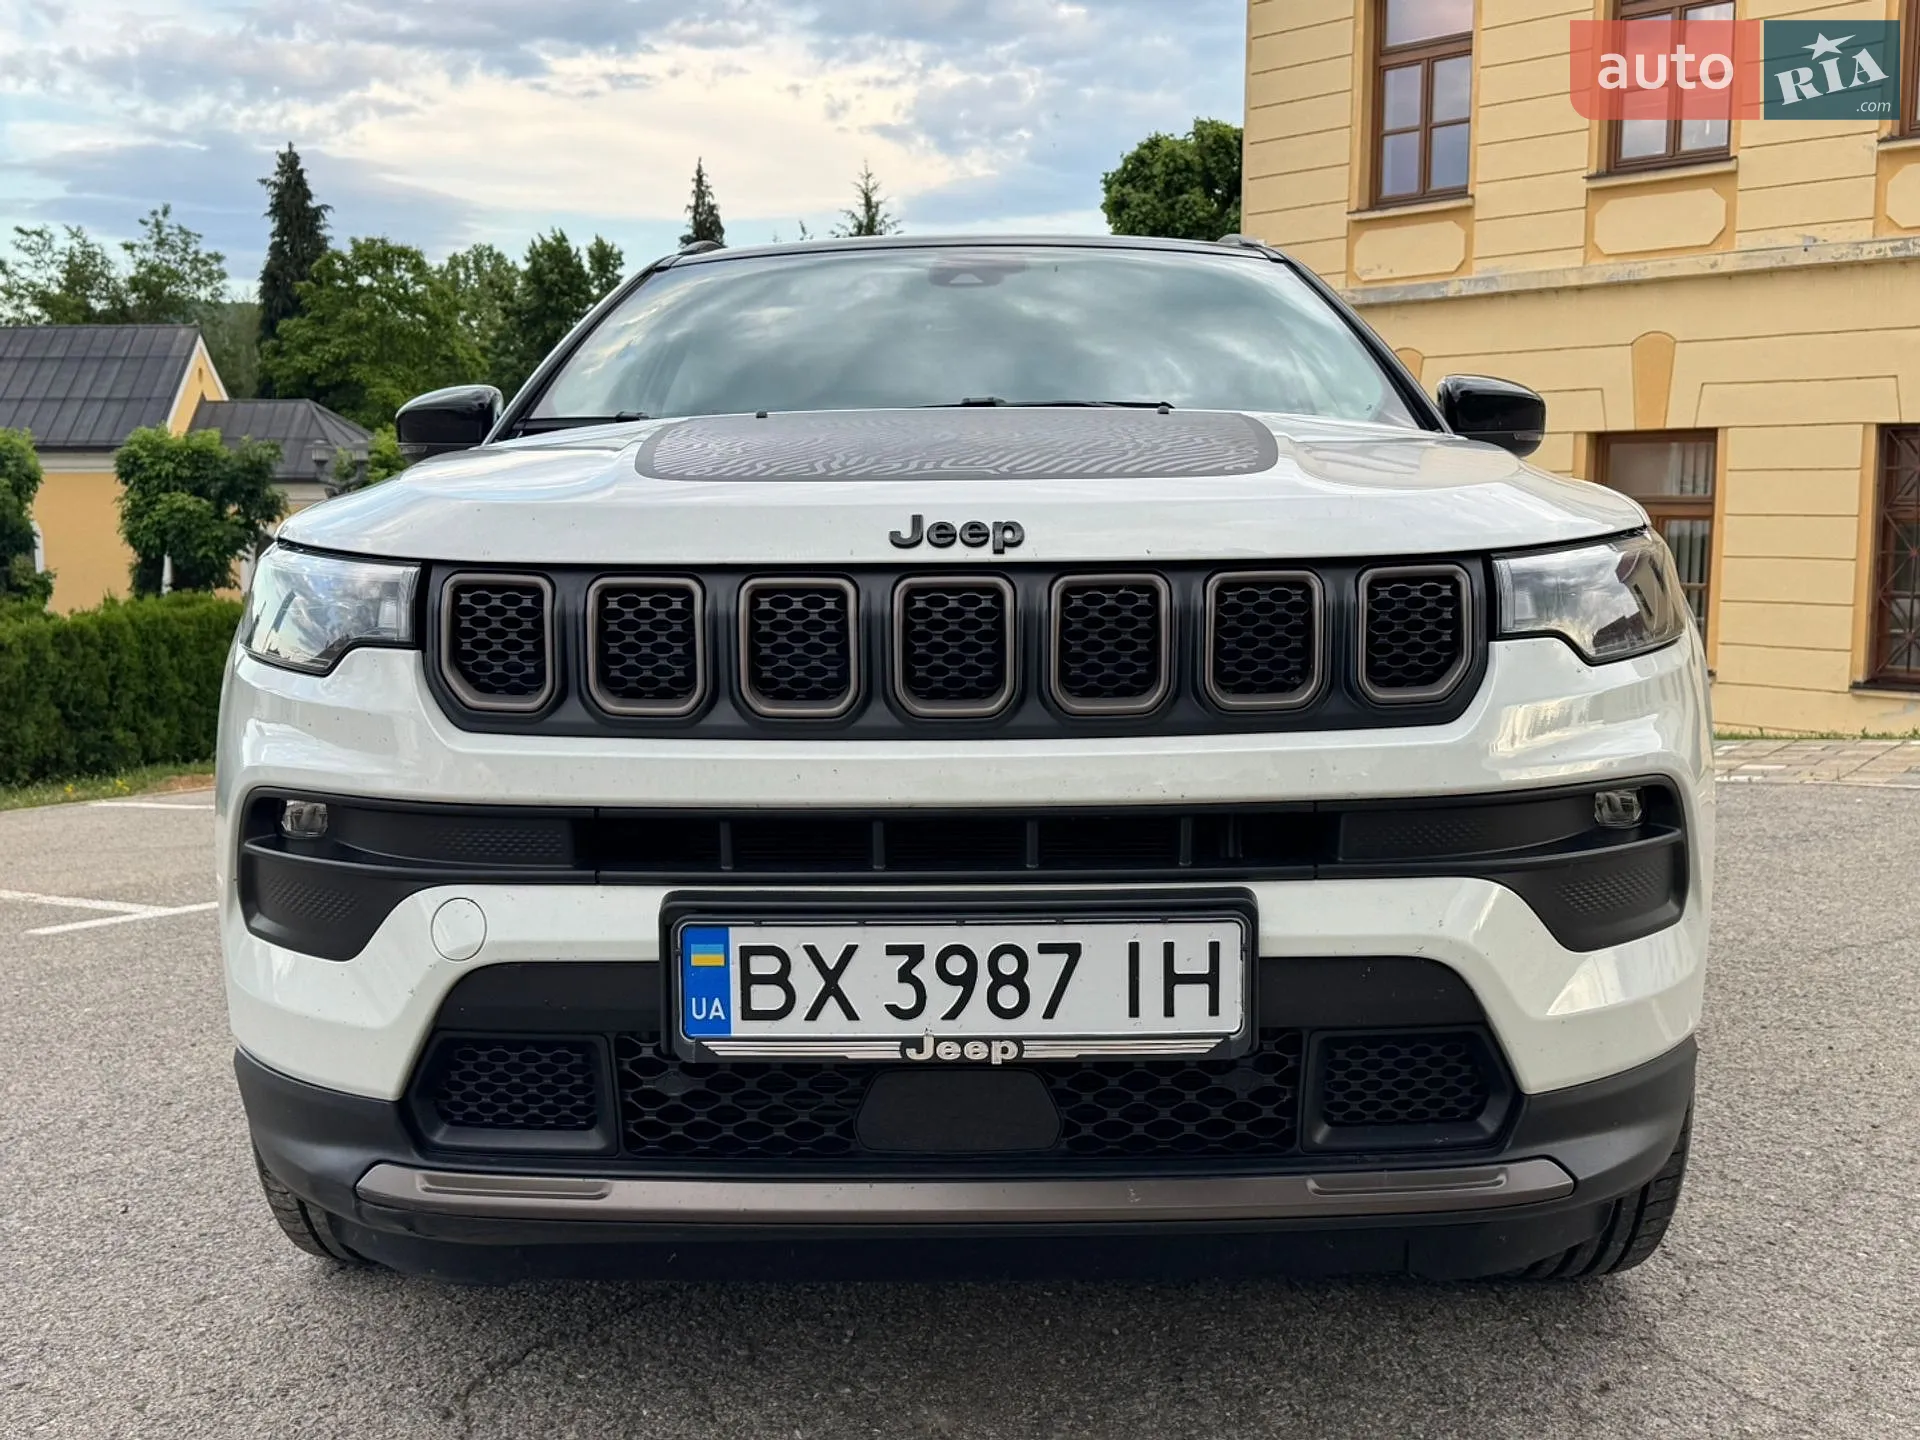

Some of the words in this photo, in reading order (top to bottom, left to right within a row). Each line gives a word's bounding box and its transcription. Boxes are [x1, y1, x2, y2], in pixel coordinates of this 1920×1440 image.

[889, 514, 1025, 554] Jeep
[738, 944, 860, 1021] BX
[884, 943, 1082, 1021] 3987
[1127, 941, 1221, 1018] IH
[691, 997, 726, 1020] UA
[905, 1034, 1018, 1065] Jeep
